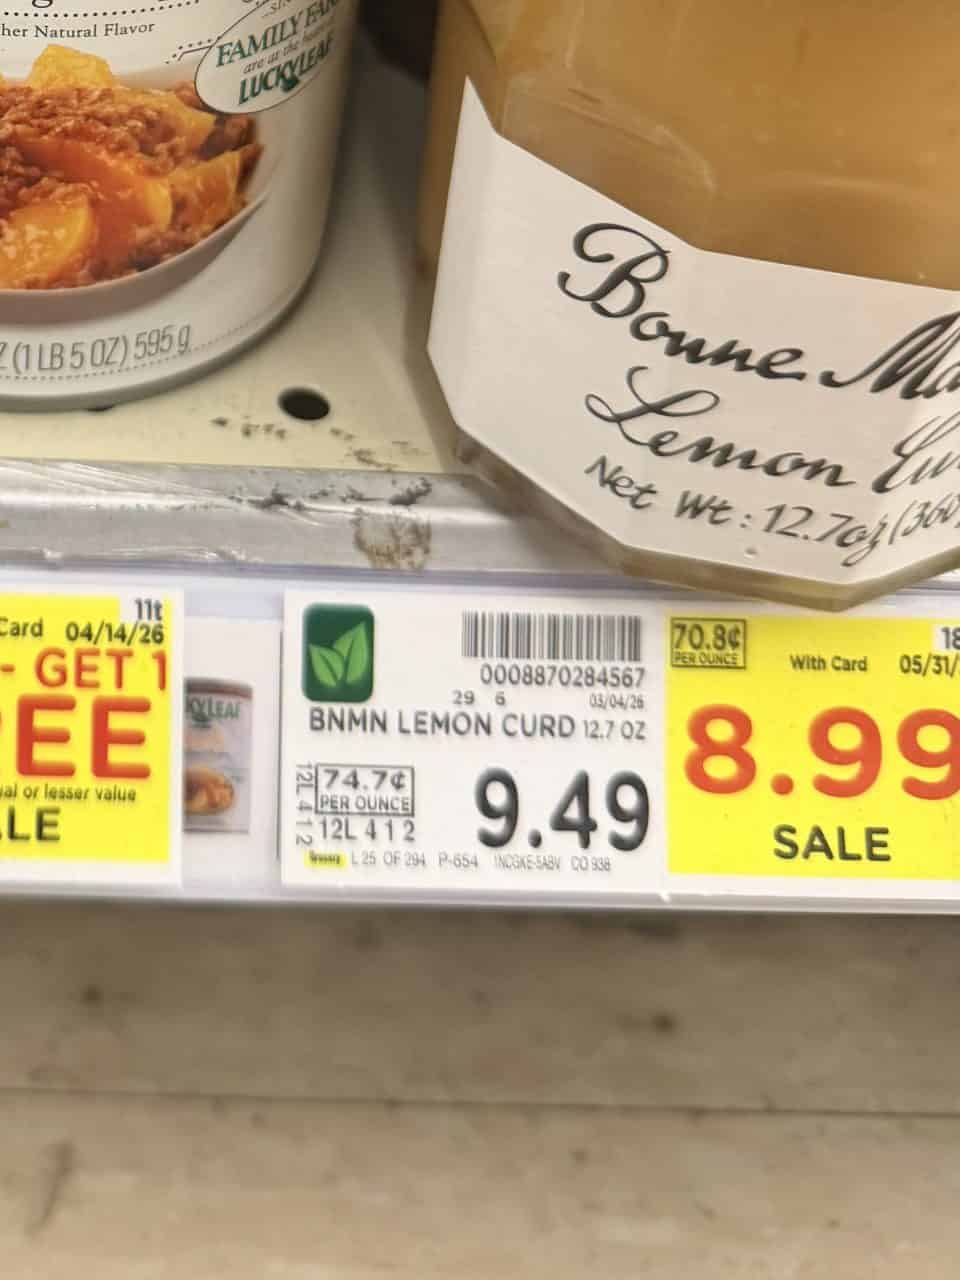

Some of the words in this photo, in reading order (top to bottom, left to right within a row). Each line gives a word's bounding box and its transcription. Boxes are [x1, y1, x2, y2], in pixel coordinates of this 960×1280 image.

[33, 21, 98, 39] Natural
[103, 20, 156, 39] Flavor
[216, 10, 303, 68] FAMILY
[557, 222, 807, 382] Bonne
[12, 340, 32, 375] (1
[37, 342, 65, 372] LB
[70, 342, 86, 370] 5
[90, 334, 130, 369] OZ)
[134, 324, 174, 361] 595
[584, 365, 857, 488] Lemon
[583, 454, 664, 510] Net
[65, 621, 165, 645] 04/14/26
[672, 622, 741, 651] 70.8¢
[34, 646, 134, 690] GET
[151, 650, 168, 691] 1
[674, 650, 696, 665] PER
[699, 651, 738, 666] OUNCE
[790, 654, 827, 671] With
[831, 655, 868, 672] Card
[480, 663, 646, 688] 0008870284567
[452, 689, 475, 706] 29
[308, 706, 388, 733] BNMN
[398, 709, 491, 737] LEMON
[502, 712, 576, 738] CURD
[583, 719, 614, 739] 12.7
[620, 720, 647, 740] OZ
[684, 703, 960, 801] 8.99
[23, 784, 39, 800] or
[43, 782, 90, 802] lesser
[95, 784, 137, 803] value
[323, 768, 406, 790] 74.7¢
[320, 794, 350, 810] PER
[354, 795, 410, 811] OUNCE
[474, 766, 650, 852] 9.49
[319, 816, 357, 839] 12L
[364, 817, 377, 840] 4
[385, 818, 393, 841] 1
[403, 819, 415, 842] 2
[773, 824, 891, 862] SALE
